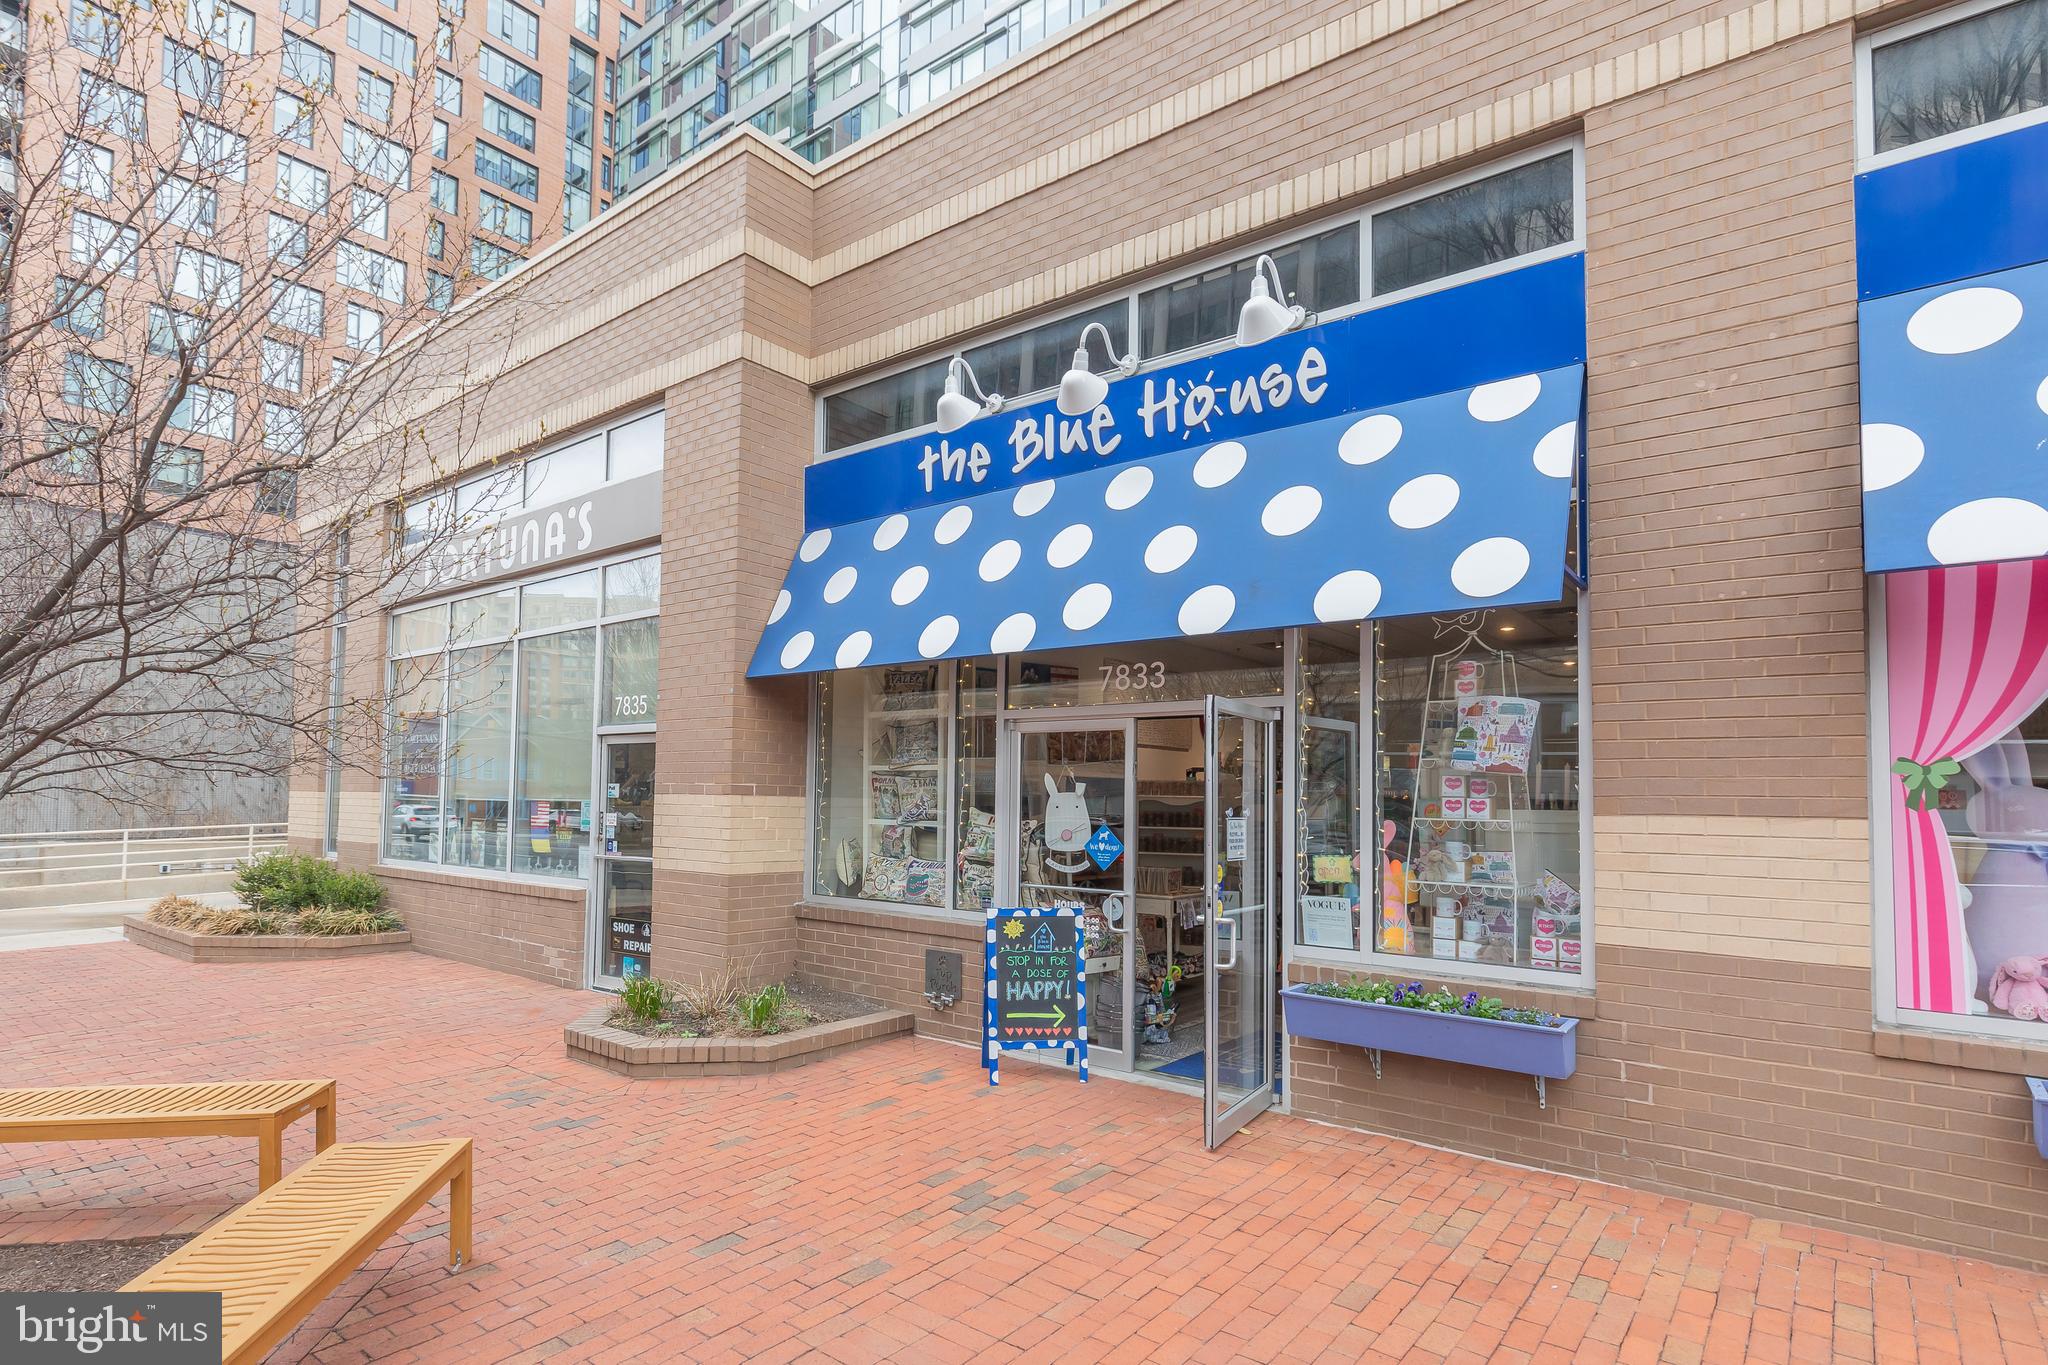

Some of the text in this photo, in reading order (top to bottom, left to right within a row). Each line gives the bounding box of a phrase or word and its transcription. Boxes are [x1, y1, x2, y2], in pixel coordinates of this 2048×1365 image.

[918, 347, 1329, 493] the Blue House
[423, 500, 593, 588] FORTUNA'S
[1099, 661, 1165, 691] 7833
[615, 694, 648, 717] 7835
[1307, 899, 1347, 911] VOGUE
[612, 921, 635, 934] SHOE
[1006, 955, 1069, 967] STOP IN FOR
[1011, 969, 1070, 978] A DOSE OF
[1005, 980, 1072, 1001] HAPPY!
